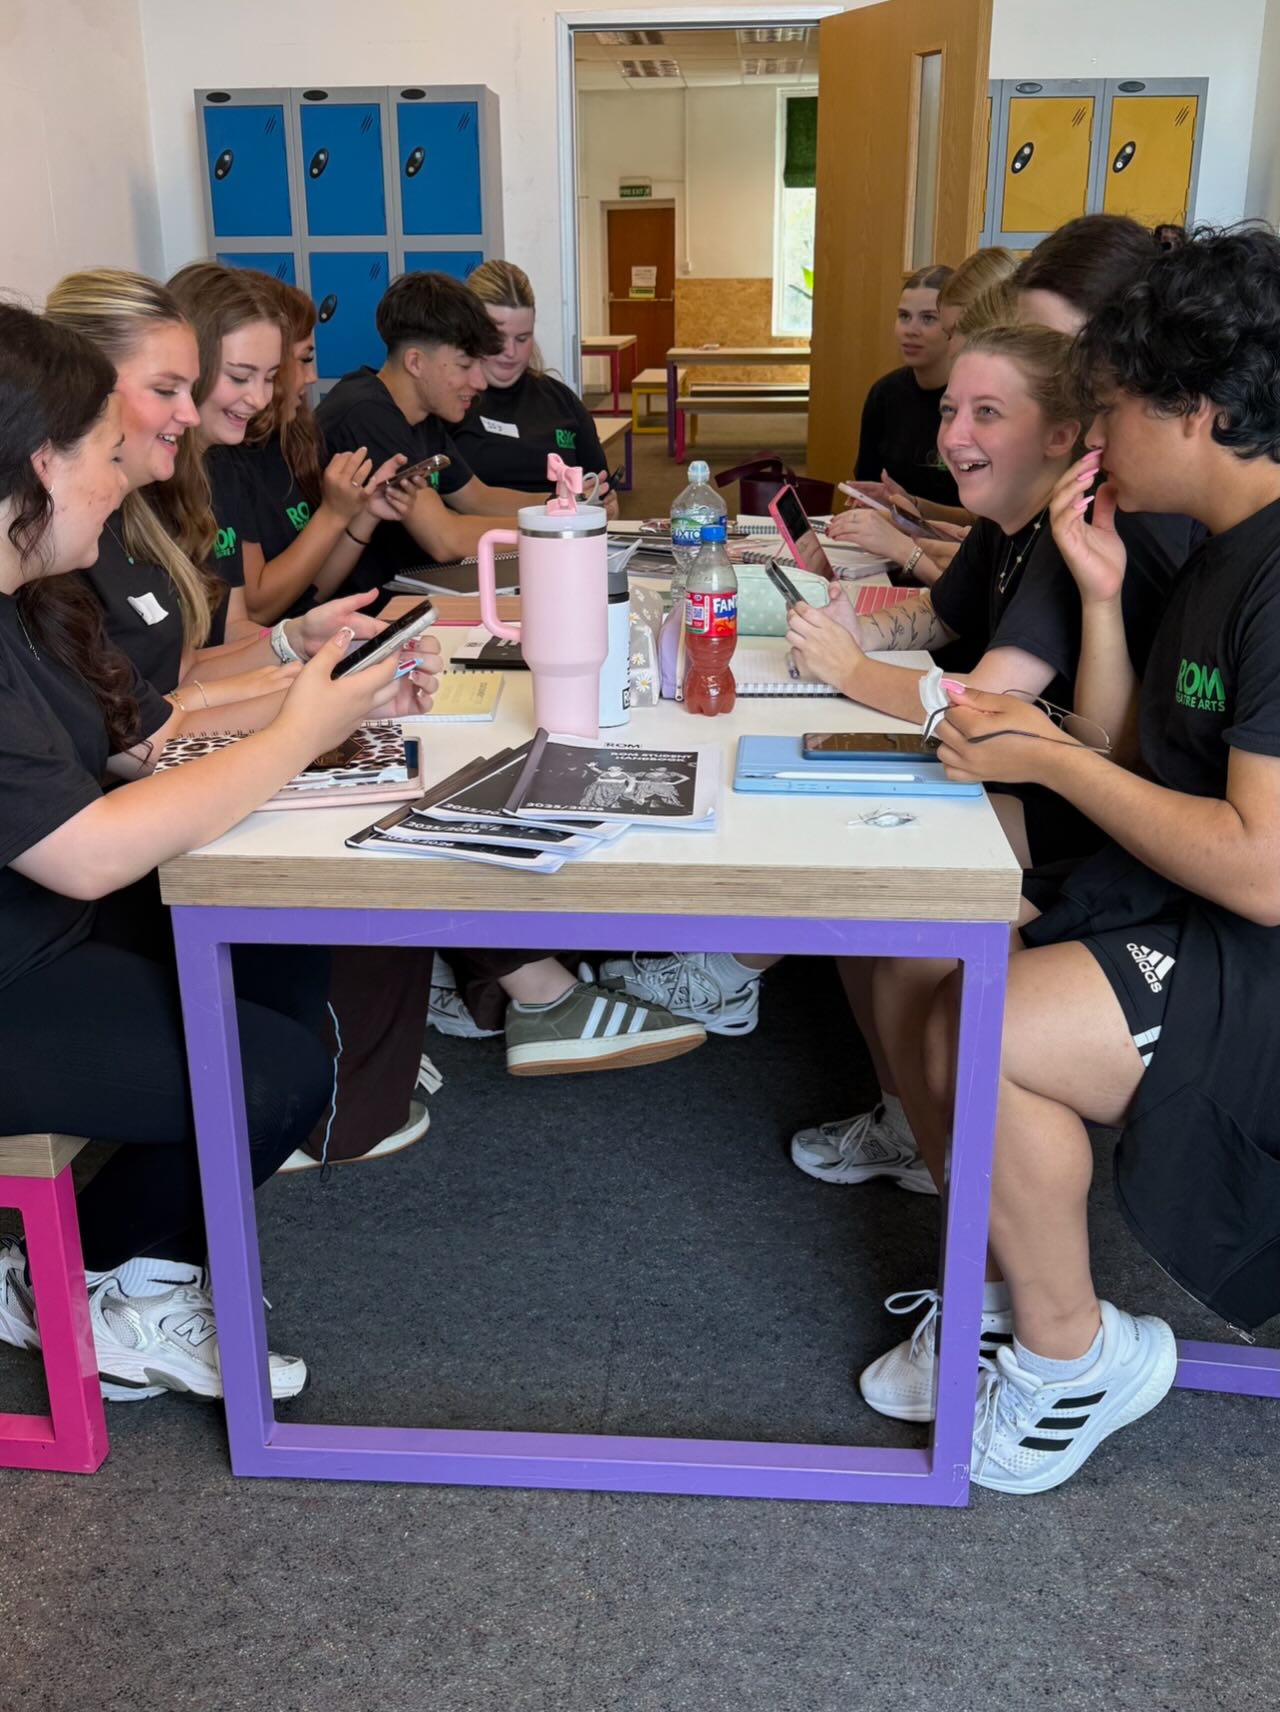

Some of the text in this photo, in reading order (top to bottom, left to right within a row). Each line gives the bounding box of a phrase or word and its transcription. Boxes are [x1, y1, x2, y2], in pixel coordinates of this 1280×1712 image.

[286, 501, 310, 529] RO
[672, 528, 701, 540] UXTO
[1197, 699, 1226, 712] ARTS
[443, 802, 501, 815] 2025/20
[405, 821, 480, 833] 2025/2026
[1126, 942, 1163, 993] adidas
[173, 1313, 218, 1348] N
